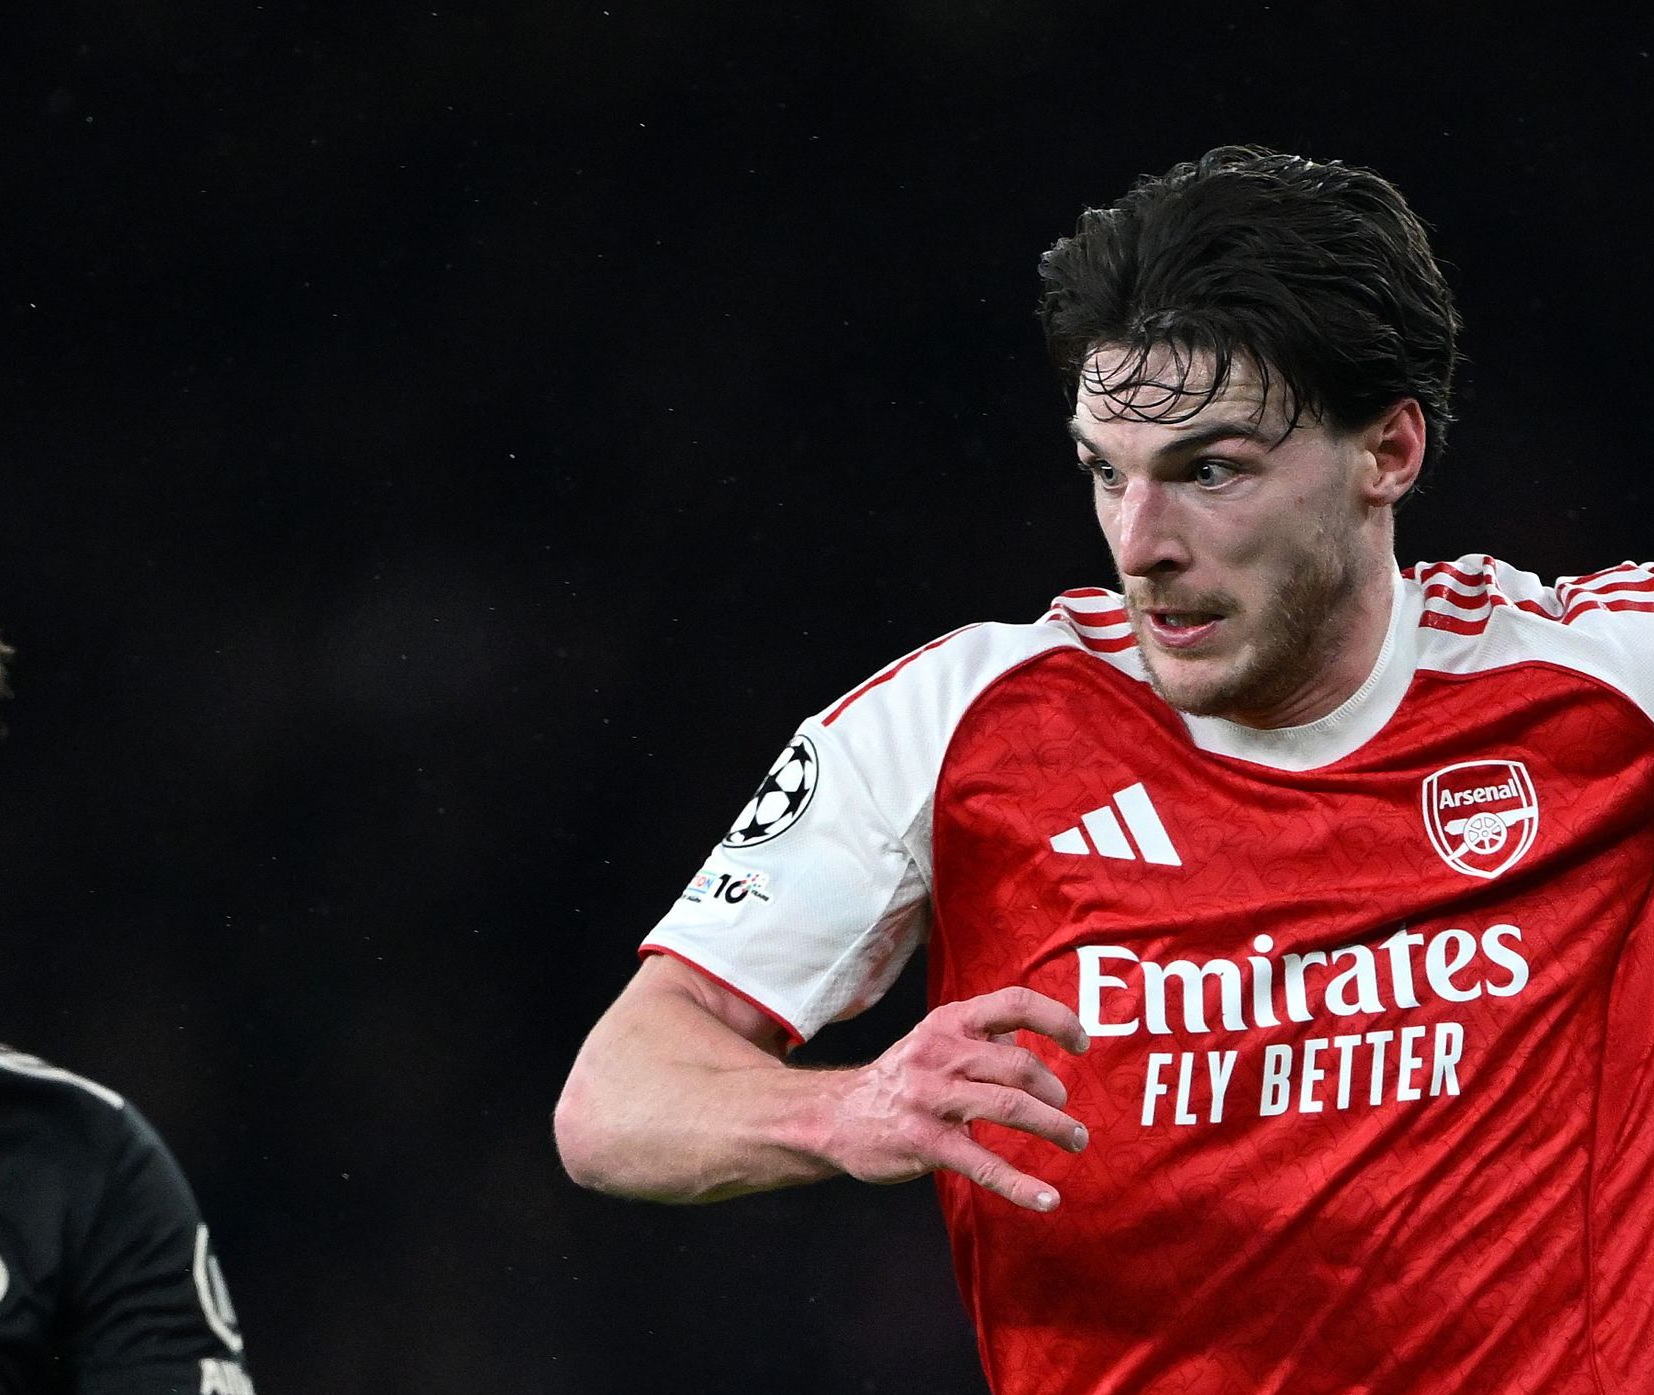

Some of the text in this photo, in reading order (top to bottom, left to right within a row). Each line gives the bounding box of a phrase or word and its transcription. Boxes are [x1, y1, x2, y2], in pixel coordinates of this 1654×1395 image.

[1439, 778, 1519, 810] Arsenal
[1076, 924, 1530, 1038] Emirates
[1140, 1022, 1465, 1127] FLY BETTER
